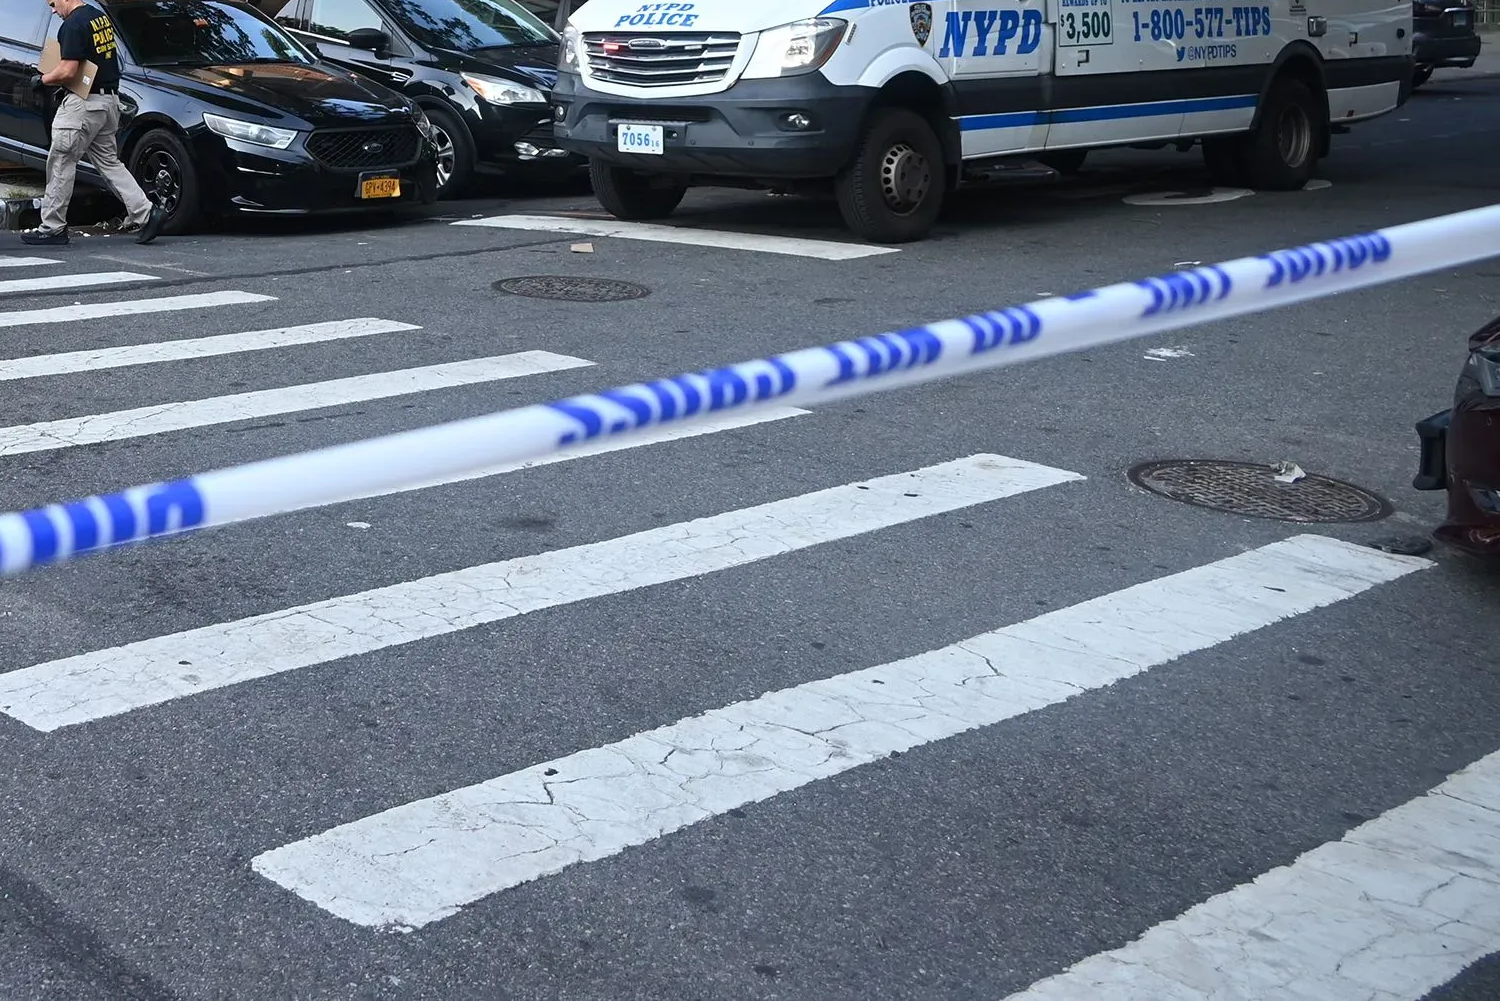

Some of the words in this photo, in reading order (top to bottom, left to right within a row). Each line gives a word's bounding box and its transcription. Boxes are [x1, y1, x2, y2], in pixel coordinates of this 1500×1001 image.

[636, 3, 695, 12] NYPD
[614, 12, 699, 27] POLICE
[1061, 11, 1110, 43] $3,500
[1133, 6, 1271, 42] 1-800-577-TIPS
[938, 9, 1042, 58] NYPD
[1188, 44, 1237, 60] @NYPDTIPS
[622, 132, 650, 146] 7056
